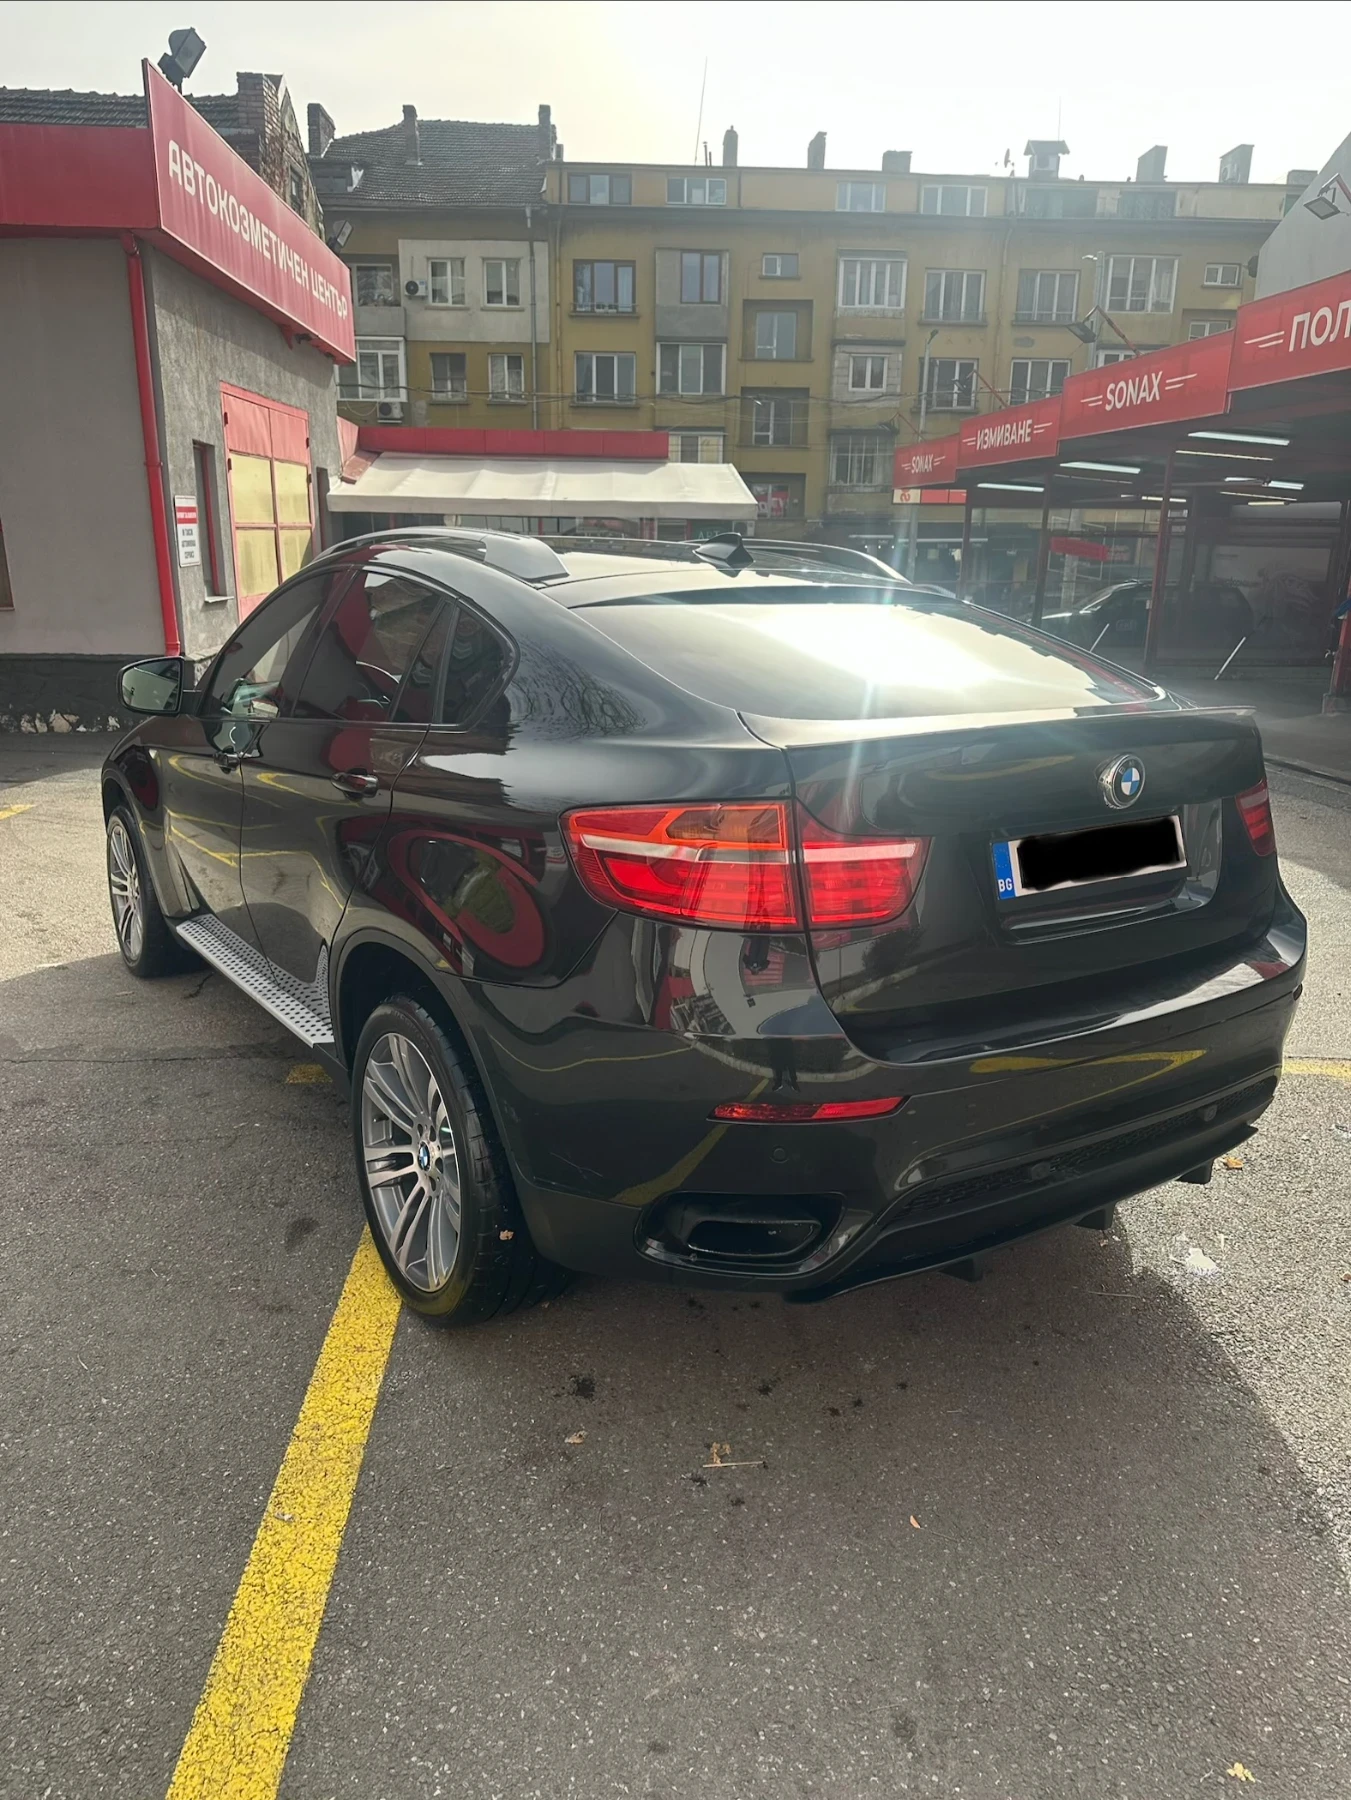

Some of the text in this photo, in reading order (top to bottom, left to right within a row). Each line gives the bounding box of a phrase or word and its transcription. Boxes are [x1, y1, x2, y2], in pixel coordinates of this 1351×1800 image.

[168, 139, 348, 320] АВТОКОЗМЕТИЧЕН ЦЕНТЪР
[1105, 370, 1163, 411] SONAX
[976, 419, 1032, 450] ИЗМИВАНЕ
[911, 454, 934, 474] SONAX
[998, 877, 1013, 892] BG
